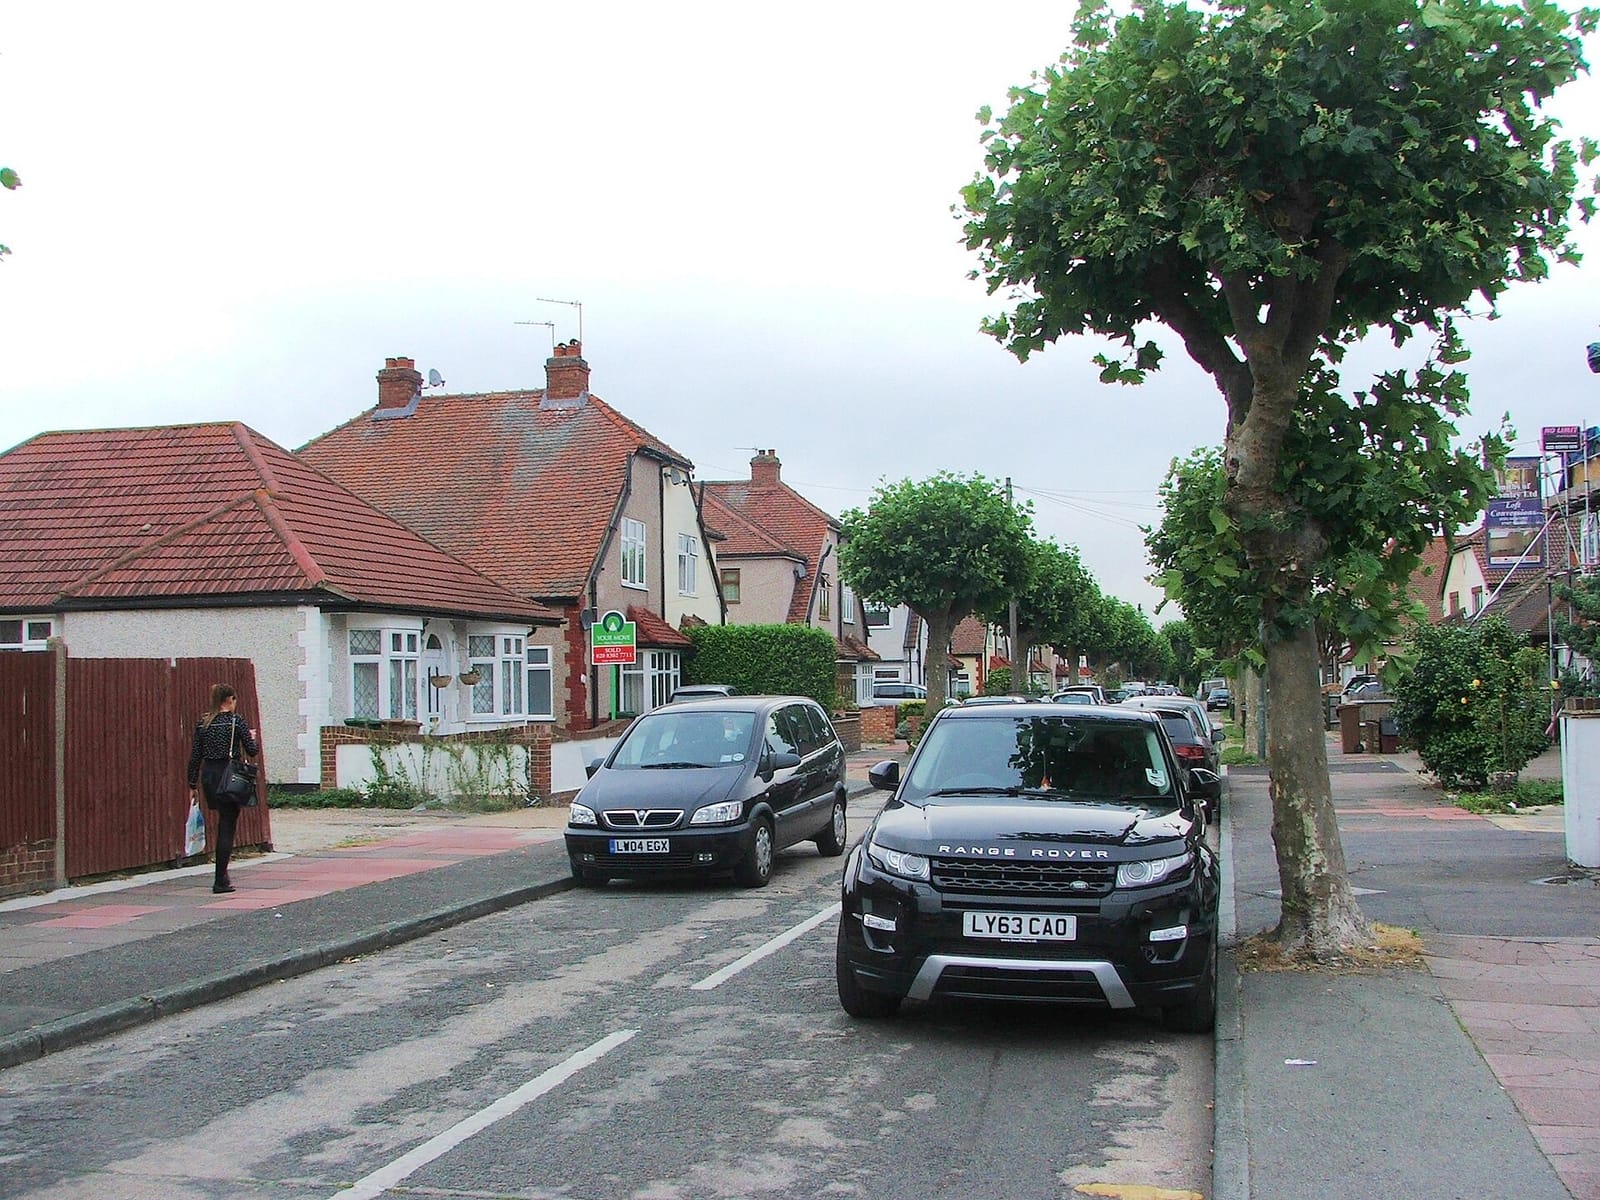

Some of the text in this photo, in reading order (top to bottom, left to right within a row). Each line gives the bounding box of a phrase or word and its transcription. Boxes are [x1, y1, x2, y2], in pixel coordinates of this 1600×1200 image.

[1505, 501, 1521, 510] Loft
[616, 840, 668, 852] LW04 EGX
[939, 845, 1109, 858] RANGE ROVER
[972, 915, 1067, 936] LY63 CAO
